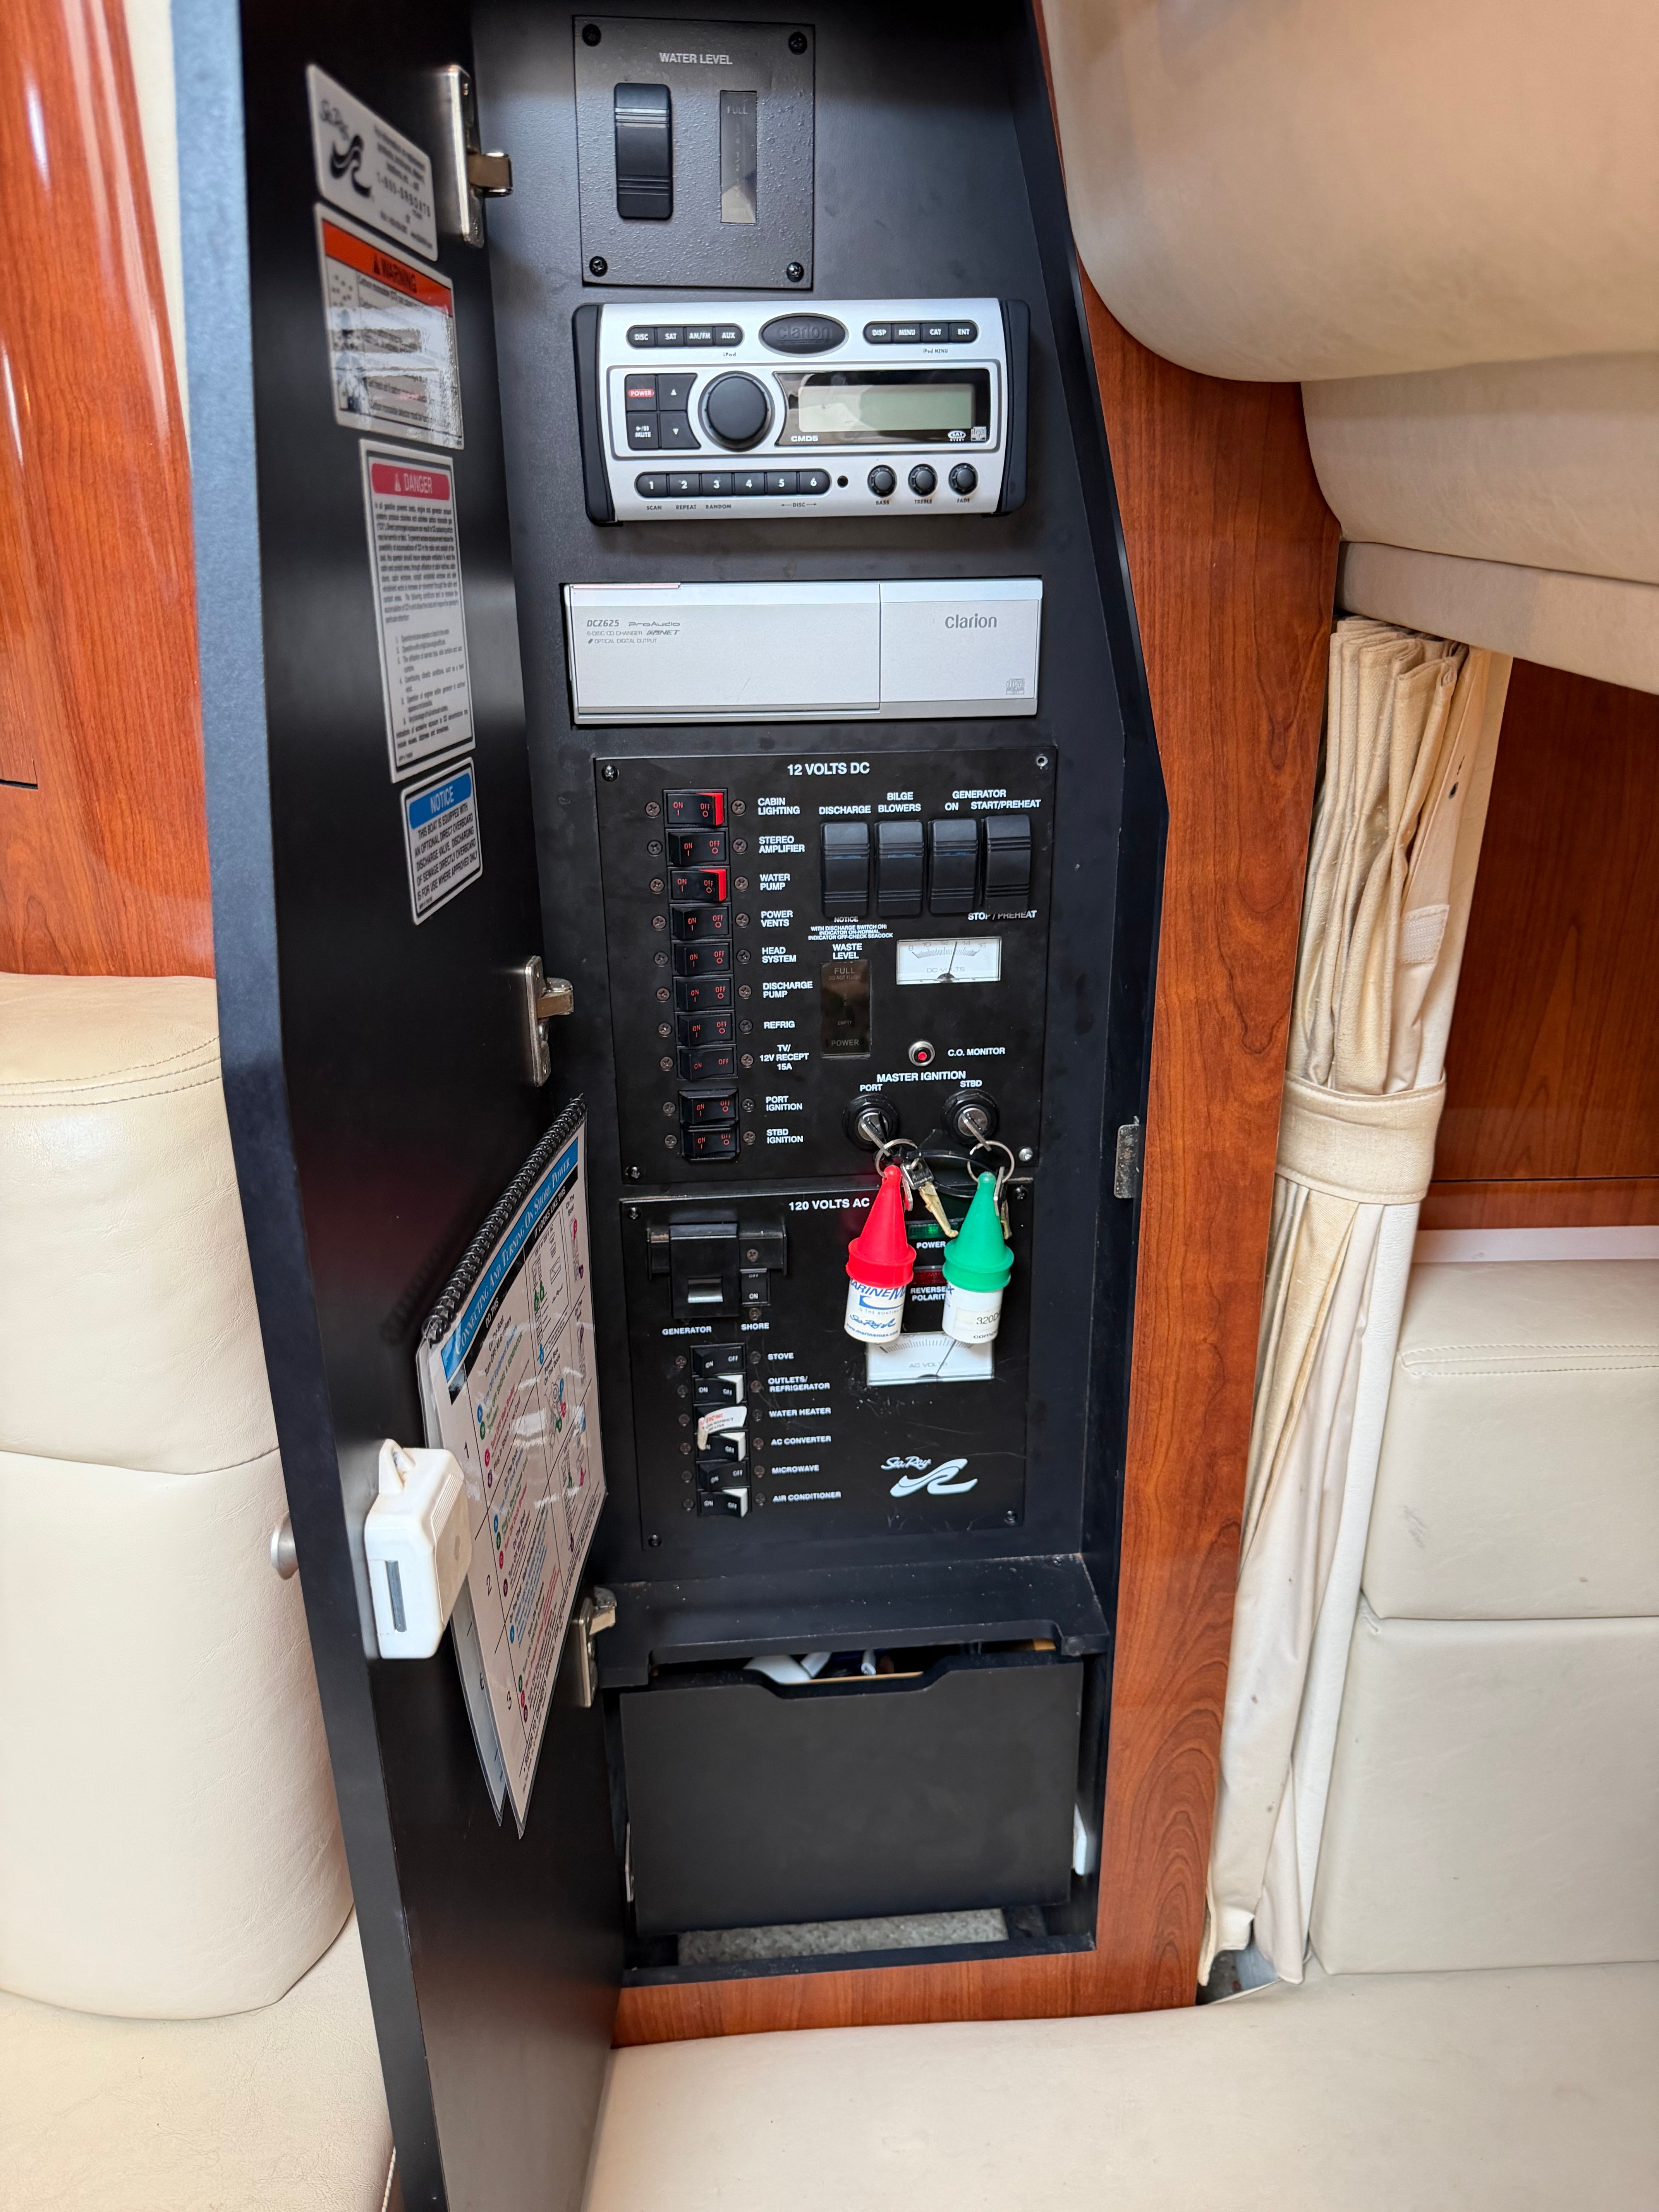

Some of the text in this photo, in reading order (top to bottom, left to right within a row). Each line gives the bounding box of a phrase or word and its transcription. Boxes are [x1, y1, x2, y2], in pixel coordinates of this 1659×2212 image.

[659, 52, 733, 65] WATER LEVEL
[404, 473, 433, 494] DANGER
[649, 478, 817, 489] 1 2 3 4 5 6
[787, 763, 870, 776] 12 VOLTS DC
[952, 790, 1006, 799] GENERATOR
[429, 785, 455, 815] NOTICE
[758, 807, 800, 815] LIGHTING
[819, 805, 871, 815] DISCHARGE
[878, 804, 921, 812] BLOWERS
[970, 799, 1041, 810] START/PREHEAT
[418, 826, 427, 840] THIS
[427, 820, 438, 835] BOAT
[759, 845, 805, 853] AMPLIFIER
[760, 874, 790, 882] WATER
[760, 883, 785, 891] PUMP
[761, 919, 789, 927] VENTS
[762, 955, 796, 963] SYSTEM
[763, 981, 813, 990] DISCHARGE
[763, 991, 787, 999] PUMP
[777, 1044, 791, 1052] TV/
[967, 1048, 1005, 1056] MONITOR
[776, 1053, 809, 1061] RECEPT
[877, 1071, 966, 1082] MASTER IGNITION
[767, 1136, 803, 1144] IGNITION
[534, 1183, 551, 1215] SHORE
[551, 1158, 570, 1188] POWER
[789, 1198, 870, 1211] 120 VOLTS AC
[538, 1212, 550, 1235] LOOKS
[550, 1197, 558, 1215] LIKE
[917, 1241, 946, 1249] POWER
[910, 1286, 946, 1294] REVERSE
[491, 1297, 499, 1317] THIS
[662, 1326, 711, 1335] GENERATOR
[741, 1322, 769, 1331] SHORE
[768, 1376, 808, 1385] OUTLETS/
[769, 1383, 830, 1392] REFRIGERATOR
[769, 1407, 831, 1417] WATER HEATER
[784, 1436, 831, 1445] CONVERTER
[464, 1441, 469, 1459] 1
[772, 1465, 819, 1474] MICROWAVE
[788, 1491, 841, 1501] CONDITIONER
[486, 1572, 492, 1597] 2
[506, 1688, 512, 1712] 3
